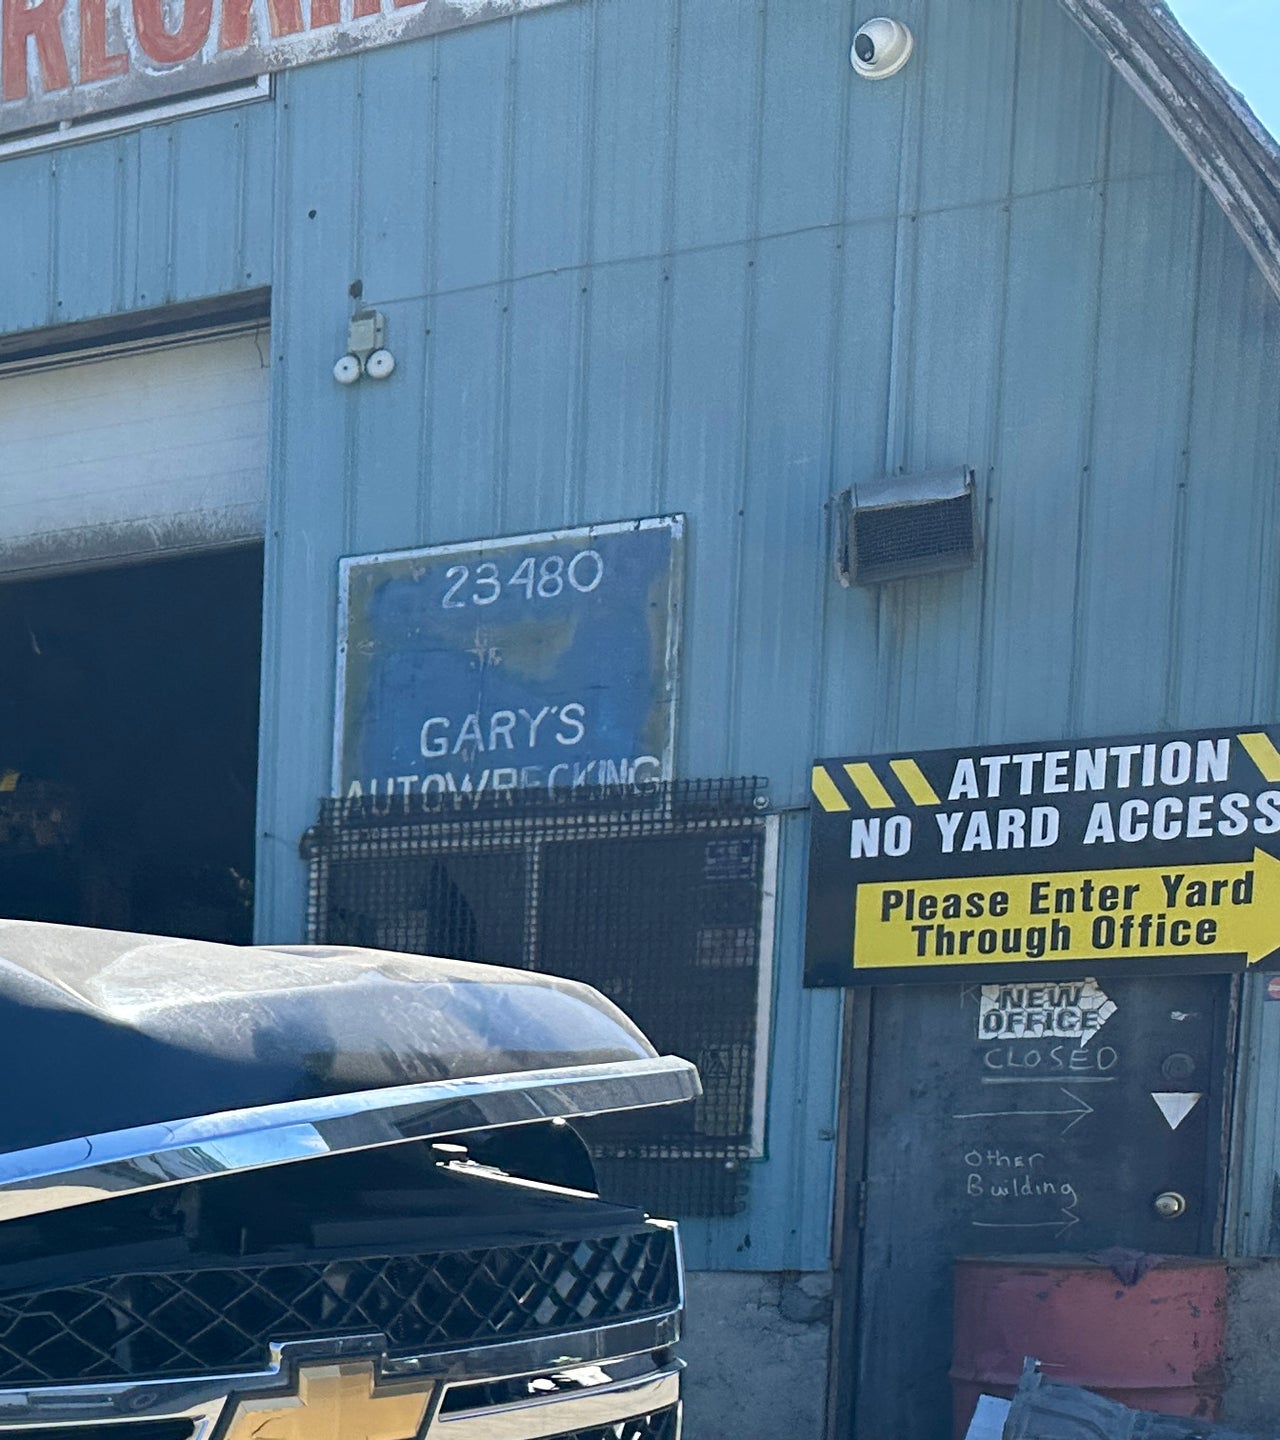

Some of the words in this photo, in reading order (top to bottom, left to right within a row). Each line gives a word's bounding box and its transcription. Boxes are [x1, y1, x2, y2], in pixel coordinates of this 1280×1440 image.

[441, 549, 604, 609] 23480
[420, 702, 586, 758] GARY'S
[947, 738, 1231, 800] ATTENTION
[850, 815, 912, 859] NO
[935, 806, 1060, 853] YARD
[1083, 790, 1280, 845] ACCESS
[881, 888, 1009, 923] Please
[1030, 879, 1140, 915] Enter
[1161, 870, 1255, 908] Yard
[911, 920, 1071, 959] Through
[1091, 912, 1217, 950] Office
[982, 1008, 1099, 1034] OFFICE
[998, 986, 1083, 1009] NEW
[983, 1045, 1118, 1071] CLOSED
[966, 1173, 1079, 1208] Building
